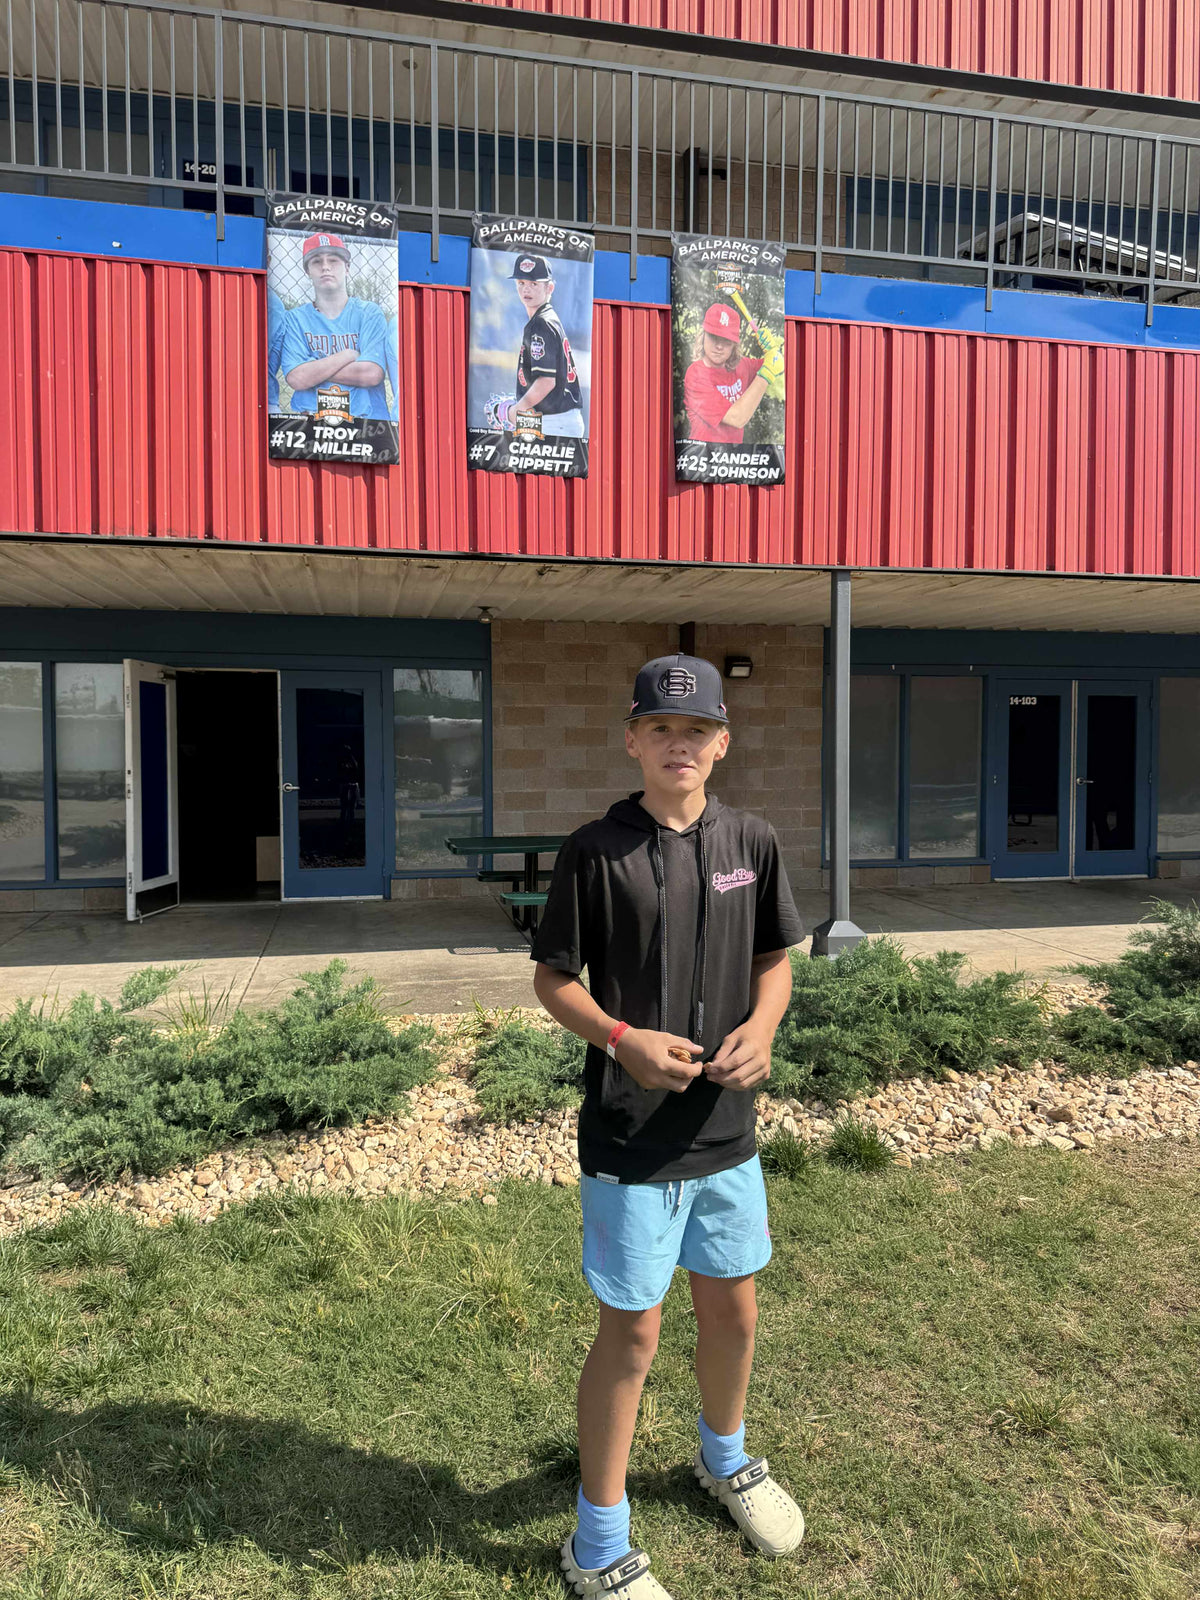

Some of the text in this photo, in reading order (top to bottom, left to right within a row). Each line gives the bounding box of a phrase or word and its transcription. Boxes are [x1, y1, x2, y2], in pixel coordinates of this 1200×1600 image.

[274, 199, 393, 227] BALLPARKS OF
[300, 211, 365, 228] AMERICA
[479, 221, 590, 251] BALLPARKS OF
[503, 232, 565, 251] AMERICA
[678, 239, 782, 265] BALLPARKS OF
[701, 250, 758, 267] AMERICA
[270, 431, 306, 448] #12
[313, 426, 358, 440] TROY
[313, 441, 373, 456] MILLER
[469, 445, 496, 461] #7
[508, 442, 576, 458] CHARLIE
[508, 456, 573, 473] PIPPETT
[676, 455, 708, 472] #25
[709, 452, 770, 466] XANDER
[709, 466, 780, 479] JOHNSON
[1009, 696, 1038, 705] 14-103
[712, 869, 738, 886] Good
